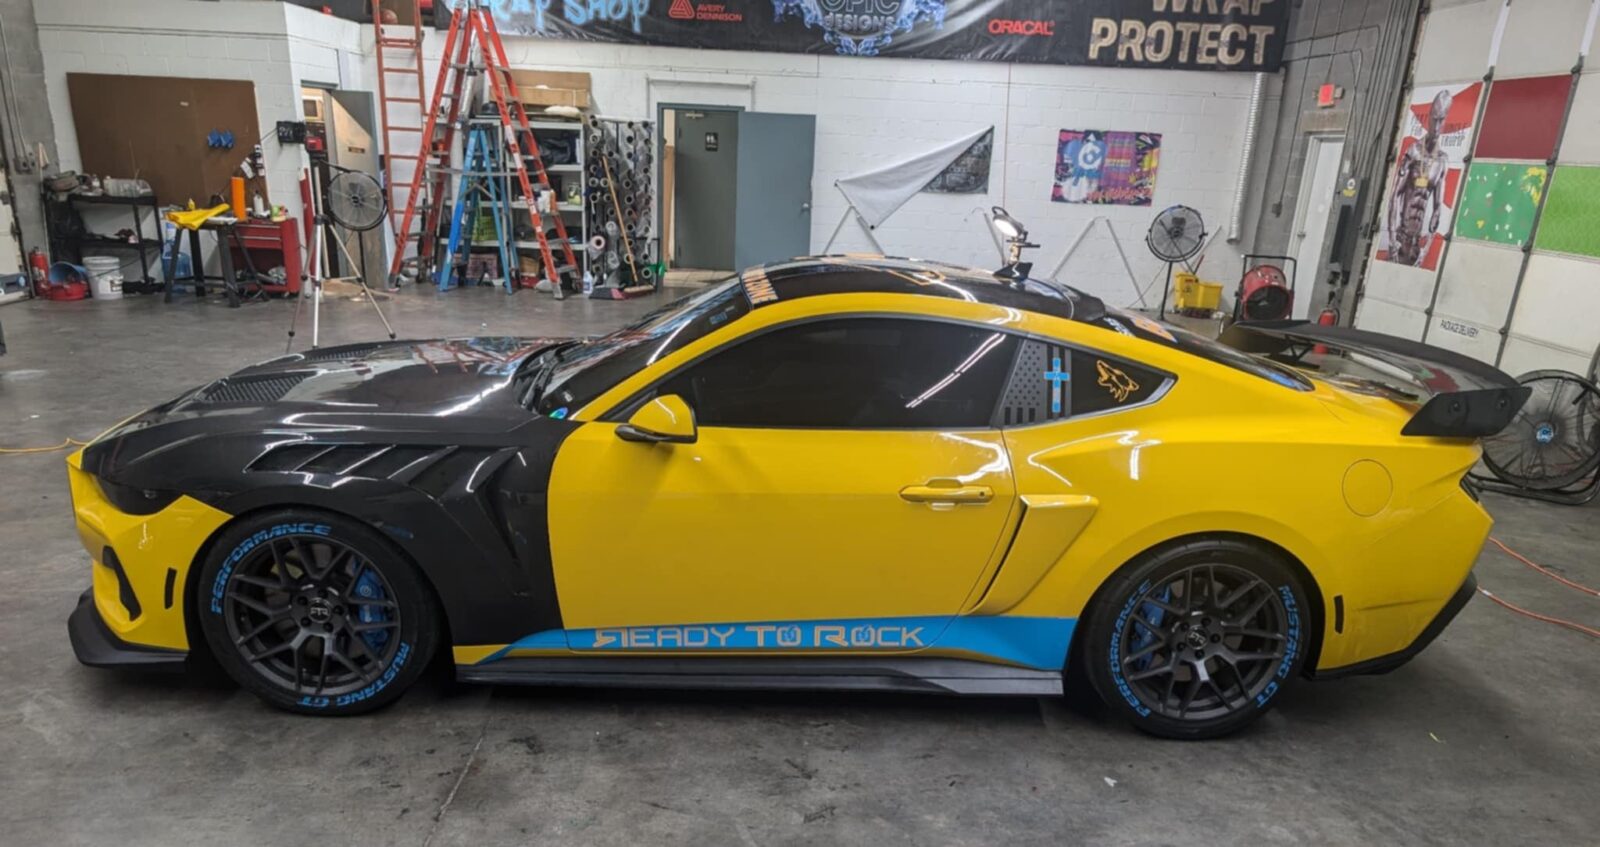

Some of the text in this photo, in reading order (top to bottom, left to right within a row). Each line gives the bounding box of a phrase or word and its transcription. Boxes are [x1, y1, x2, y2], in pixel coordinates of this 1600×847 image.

[696, 12, 743, 21] DENNISON
[1088, 17, 1275, 66] PROTECT
[210, 522, 332, 616] PERFORMANCE
[744, 624, 802, 647] TO
[813, 624, 926, 648] ROCK
[1255, 585, 1300, 708] MUSTANG GT
[296, 641, 411, 708] MUSTANG GT
